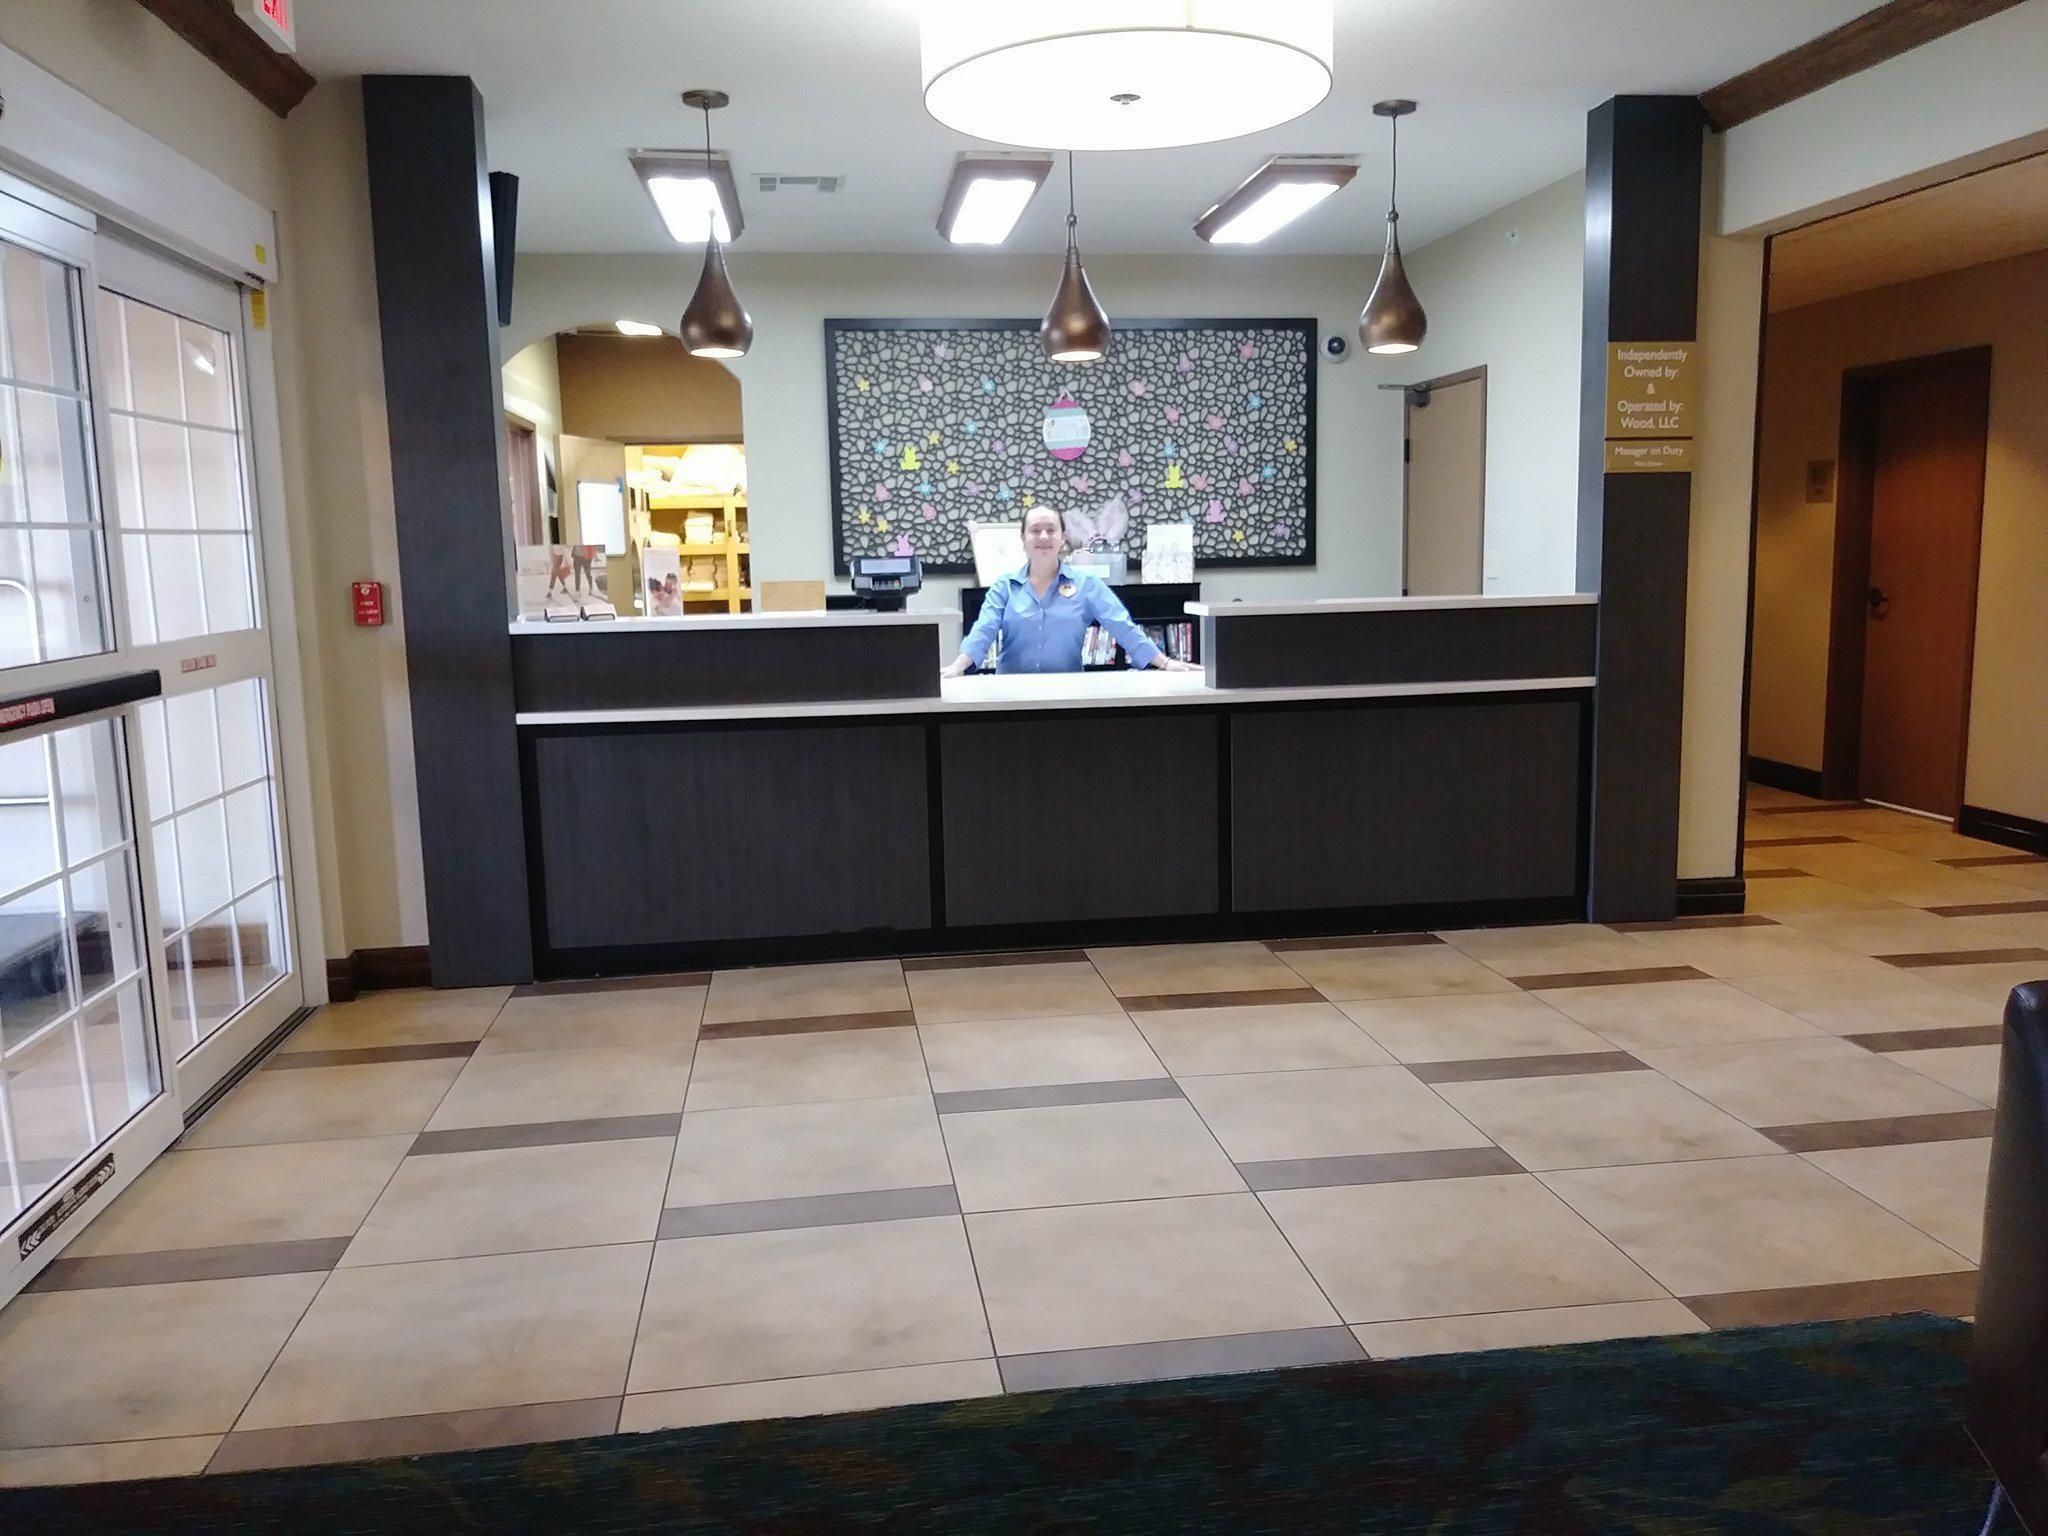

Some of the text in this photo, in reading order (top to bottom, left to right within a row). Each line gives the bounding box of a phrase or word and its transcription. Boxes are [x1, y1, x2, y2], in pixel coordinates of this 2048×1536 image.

[1617, 349, 1688, 363] Independently
[1624, 365, 1662, 378] Owned
[1646, 383, 1655, 395] &
[1617, 400, 1666, 414] Operated
[1659, 417, 1680, 429] LLC
[1615, 445, 1684, 457] Manager on Duty
